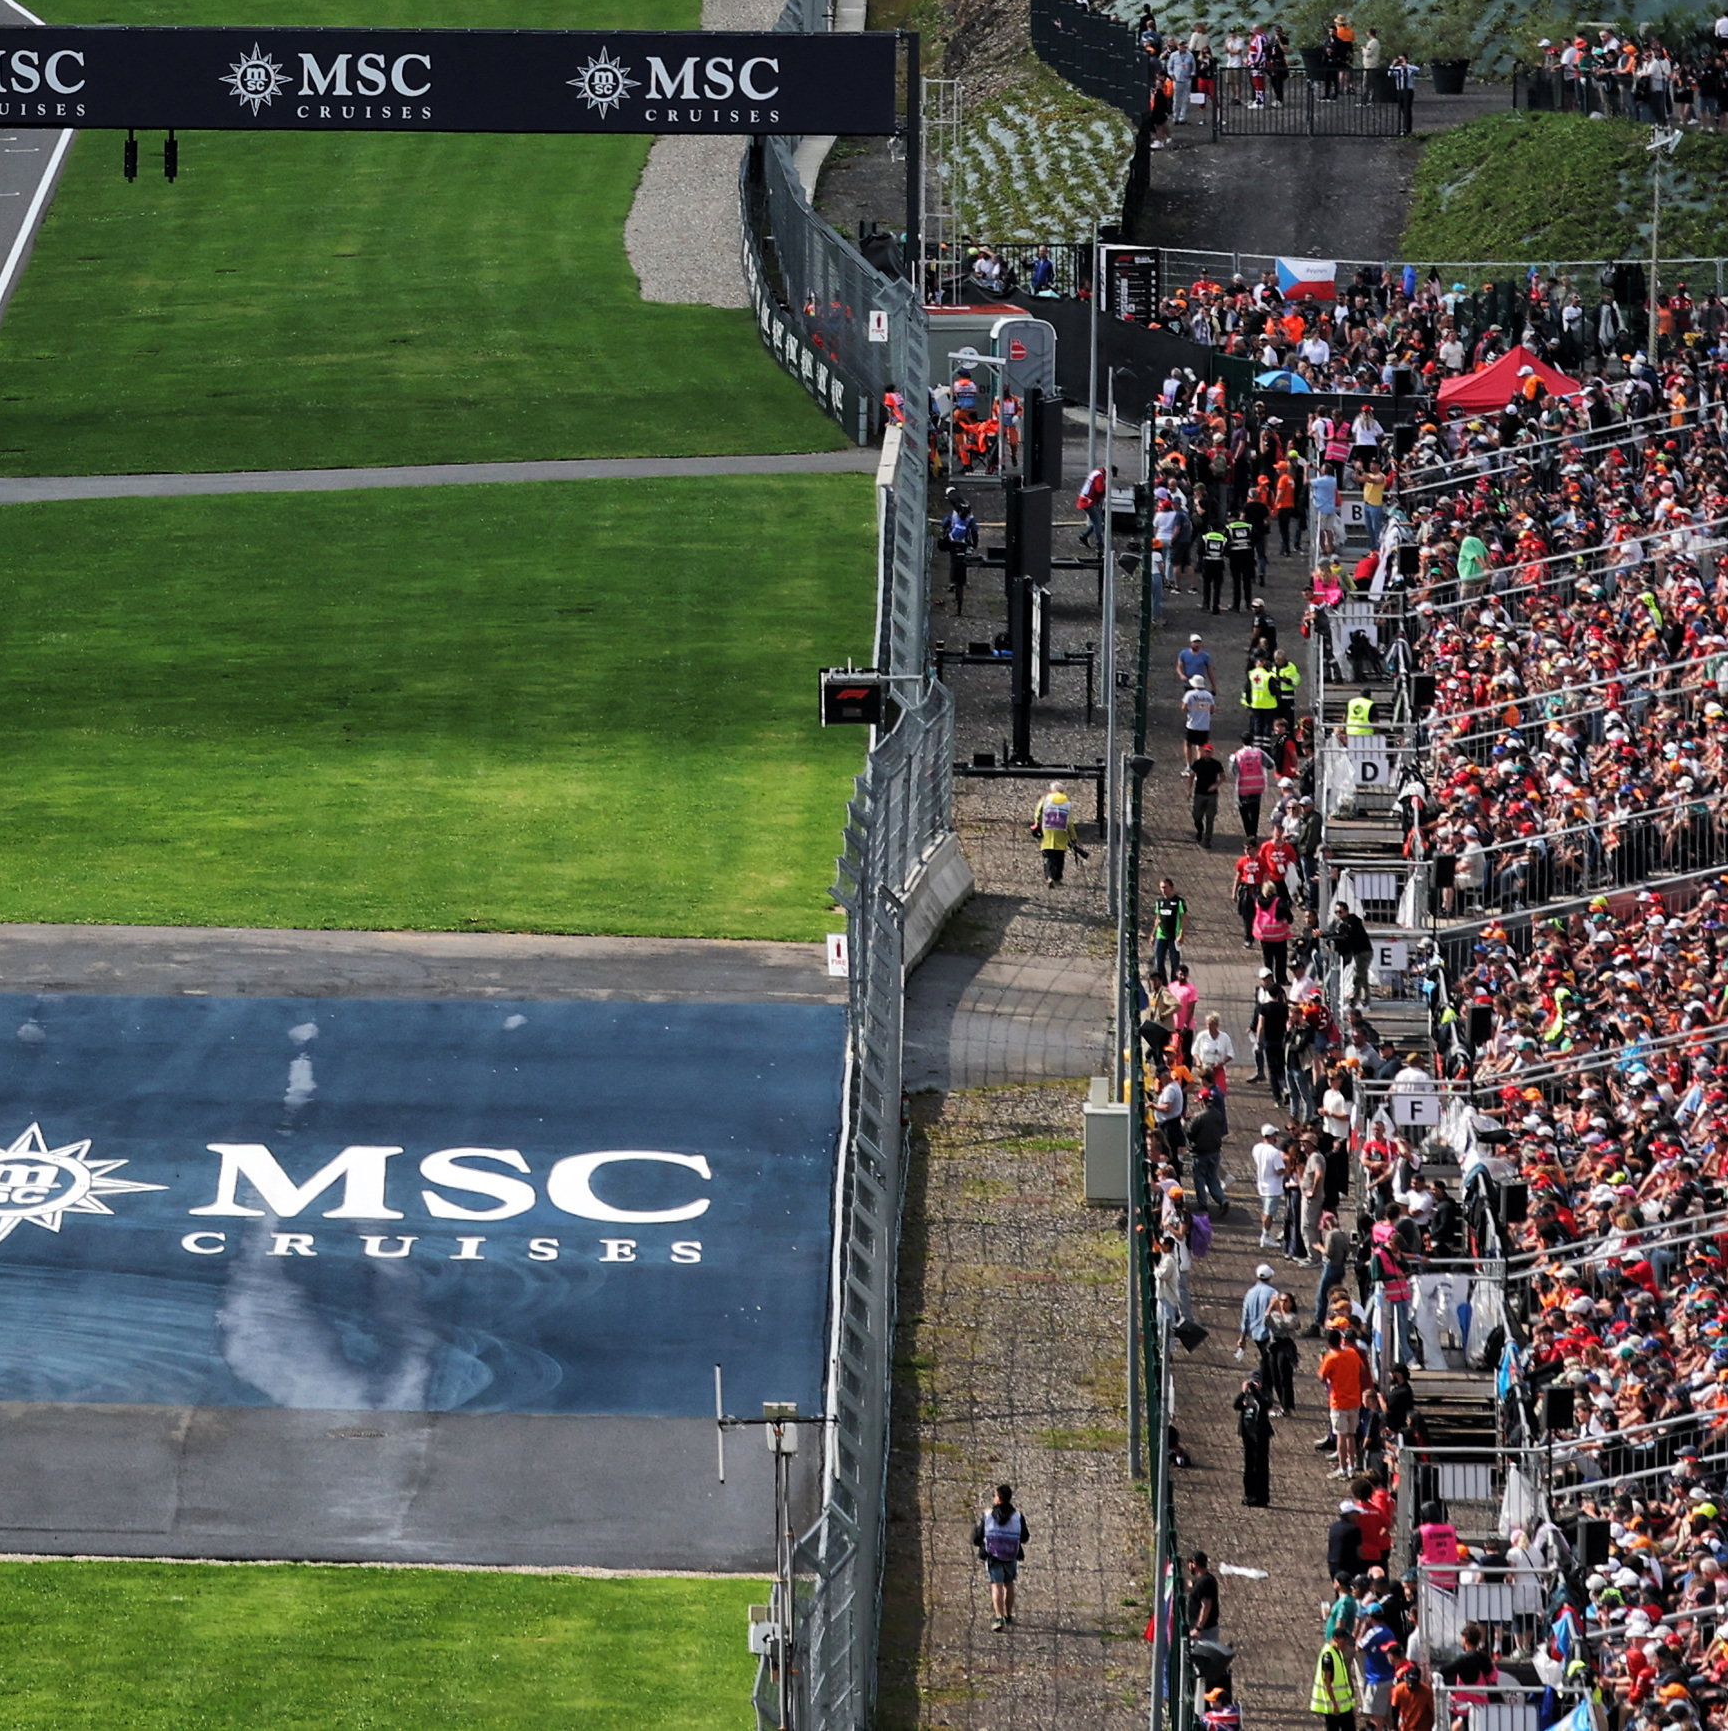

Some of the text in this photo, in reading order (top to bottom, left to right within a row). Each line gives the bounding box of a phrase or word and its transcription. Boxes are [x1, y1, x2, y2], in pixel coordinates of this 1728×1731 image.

[297, 53, 432, 97] MSC
[645, 57, 780, 101] MSC
[297, 106, 432, 119] CRUISES
[645, 110, 780, 123] CRUISES
[1352, 505, 1362, 520] B
[1362, 763, 1378, 781] D
[1381, 949, 1392, 966] E
[1411, 1103, 1422, 1120] F
[190, 1144, 710, 1224] MSC
[182, 1232, 703, 1265] CRUISES
